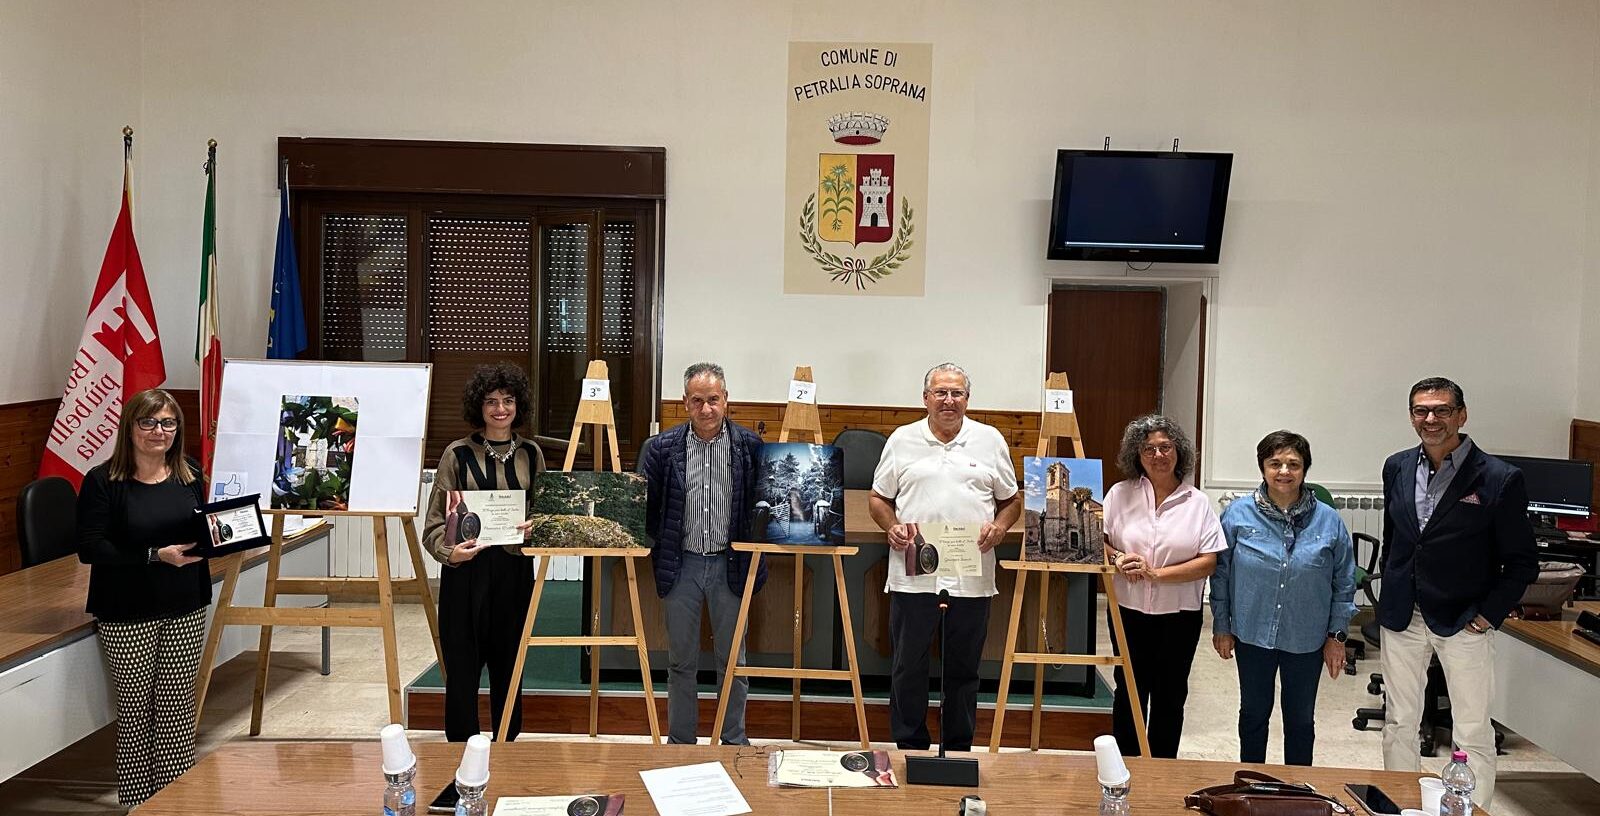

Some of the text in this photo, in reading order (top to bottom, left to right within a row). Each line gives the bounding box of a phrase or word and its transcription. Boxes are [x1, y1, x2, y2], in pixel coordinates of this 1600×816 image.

[821, 48, 898, 67] COMUNE DI
[794, 74, 926, 102] PETRALIA SOPRANA
[796, 389, 809, 400] 2°
